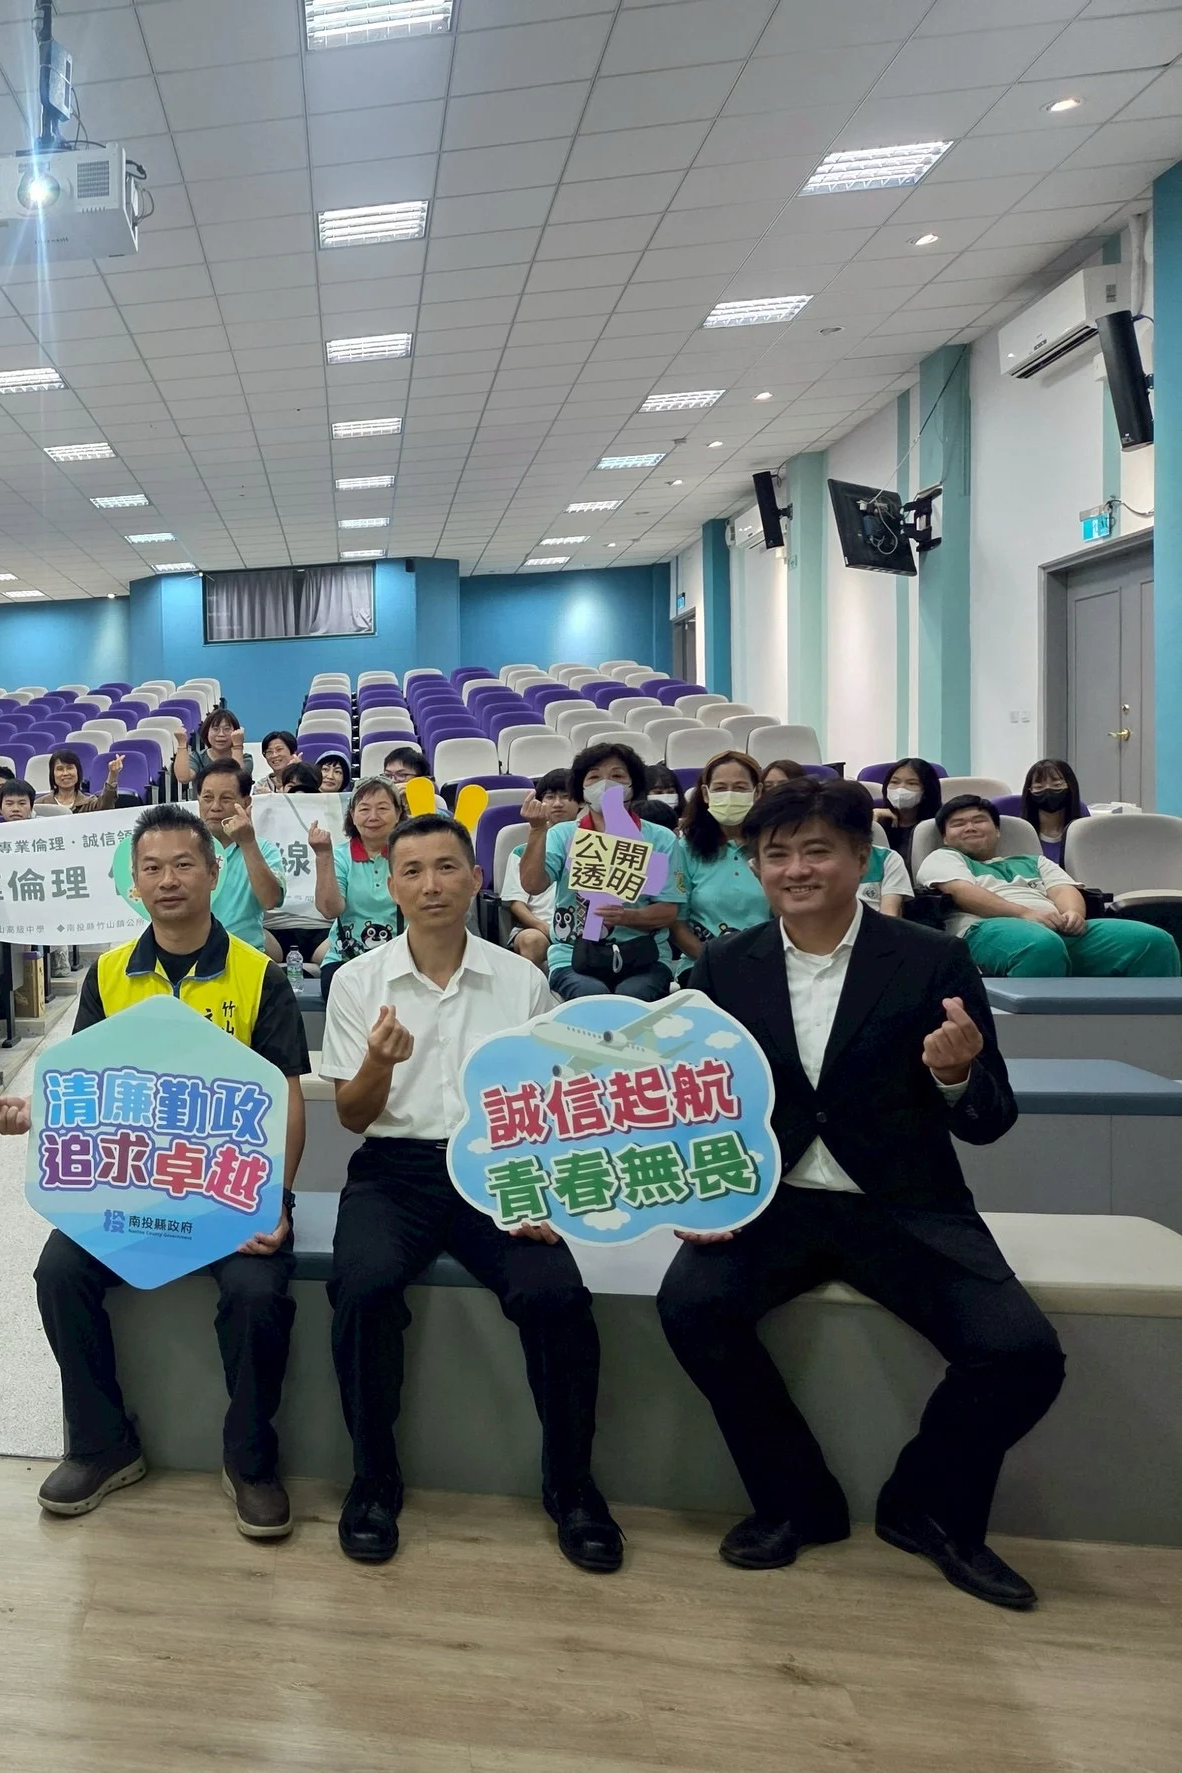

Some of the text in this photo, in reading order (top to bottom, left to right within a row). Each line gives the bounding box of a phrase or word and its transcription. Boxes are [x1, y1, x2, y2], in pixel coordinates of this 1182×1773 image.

[571, 861, 646, 901] 透明
[575, 833, 649, 871] 公開
[44, 1068, 270, 1144] 清廉勤政
[482, 1058, 739, 1147] 誠信起航
[42, 1131, 268, 1213] 追求卓越
[485, 1131, 758, 1222] 青春無畏
[128, 1215, 193, 1234] 南投縣政府
